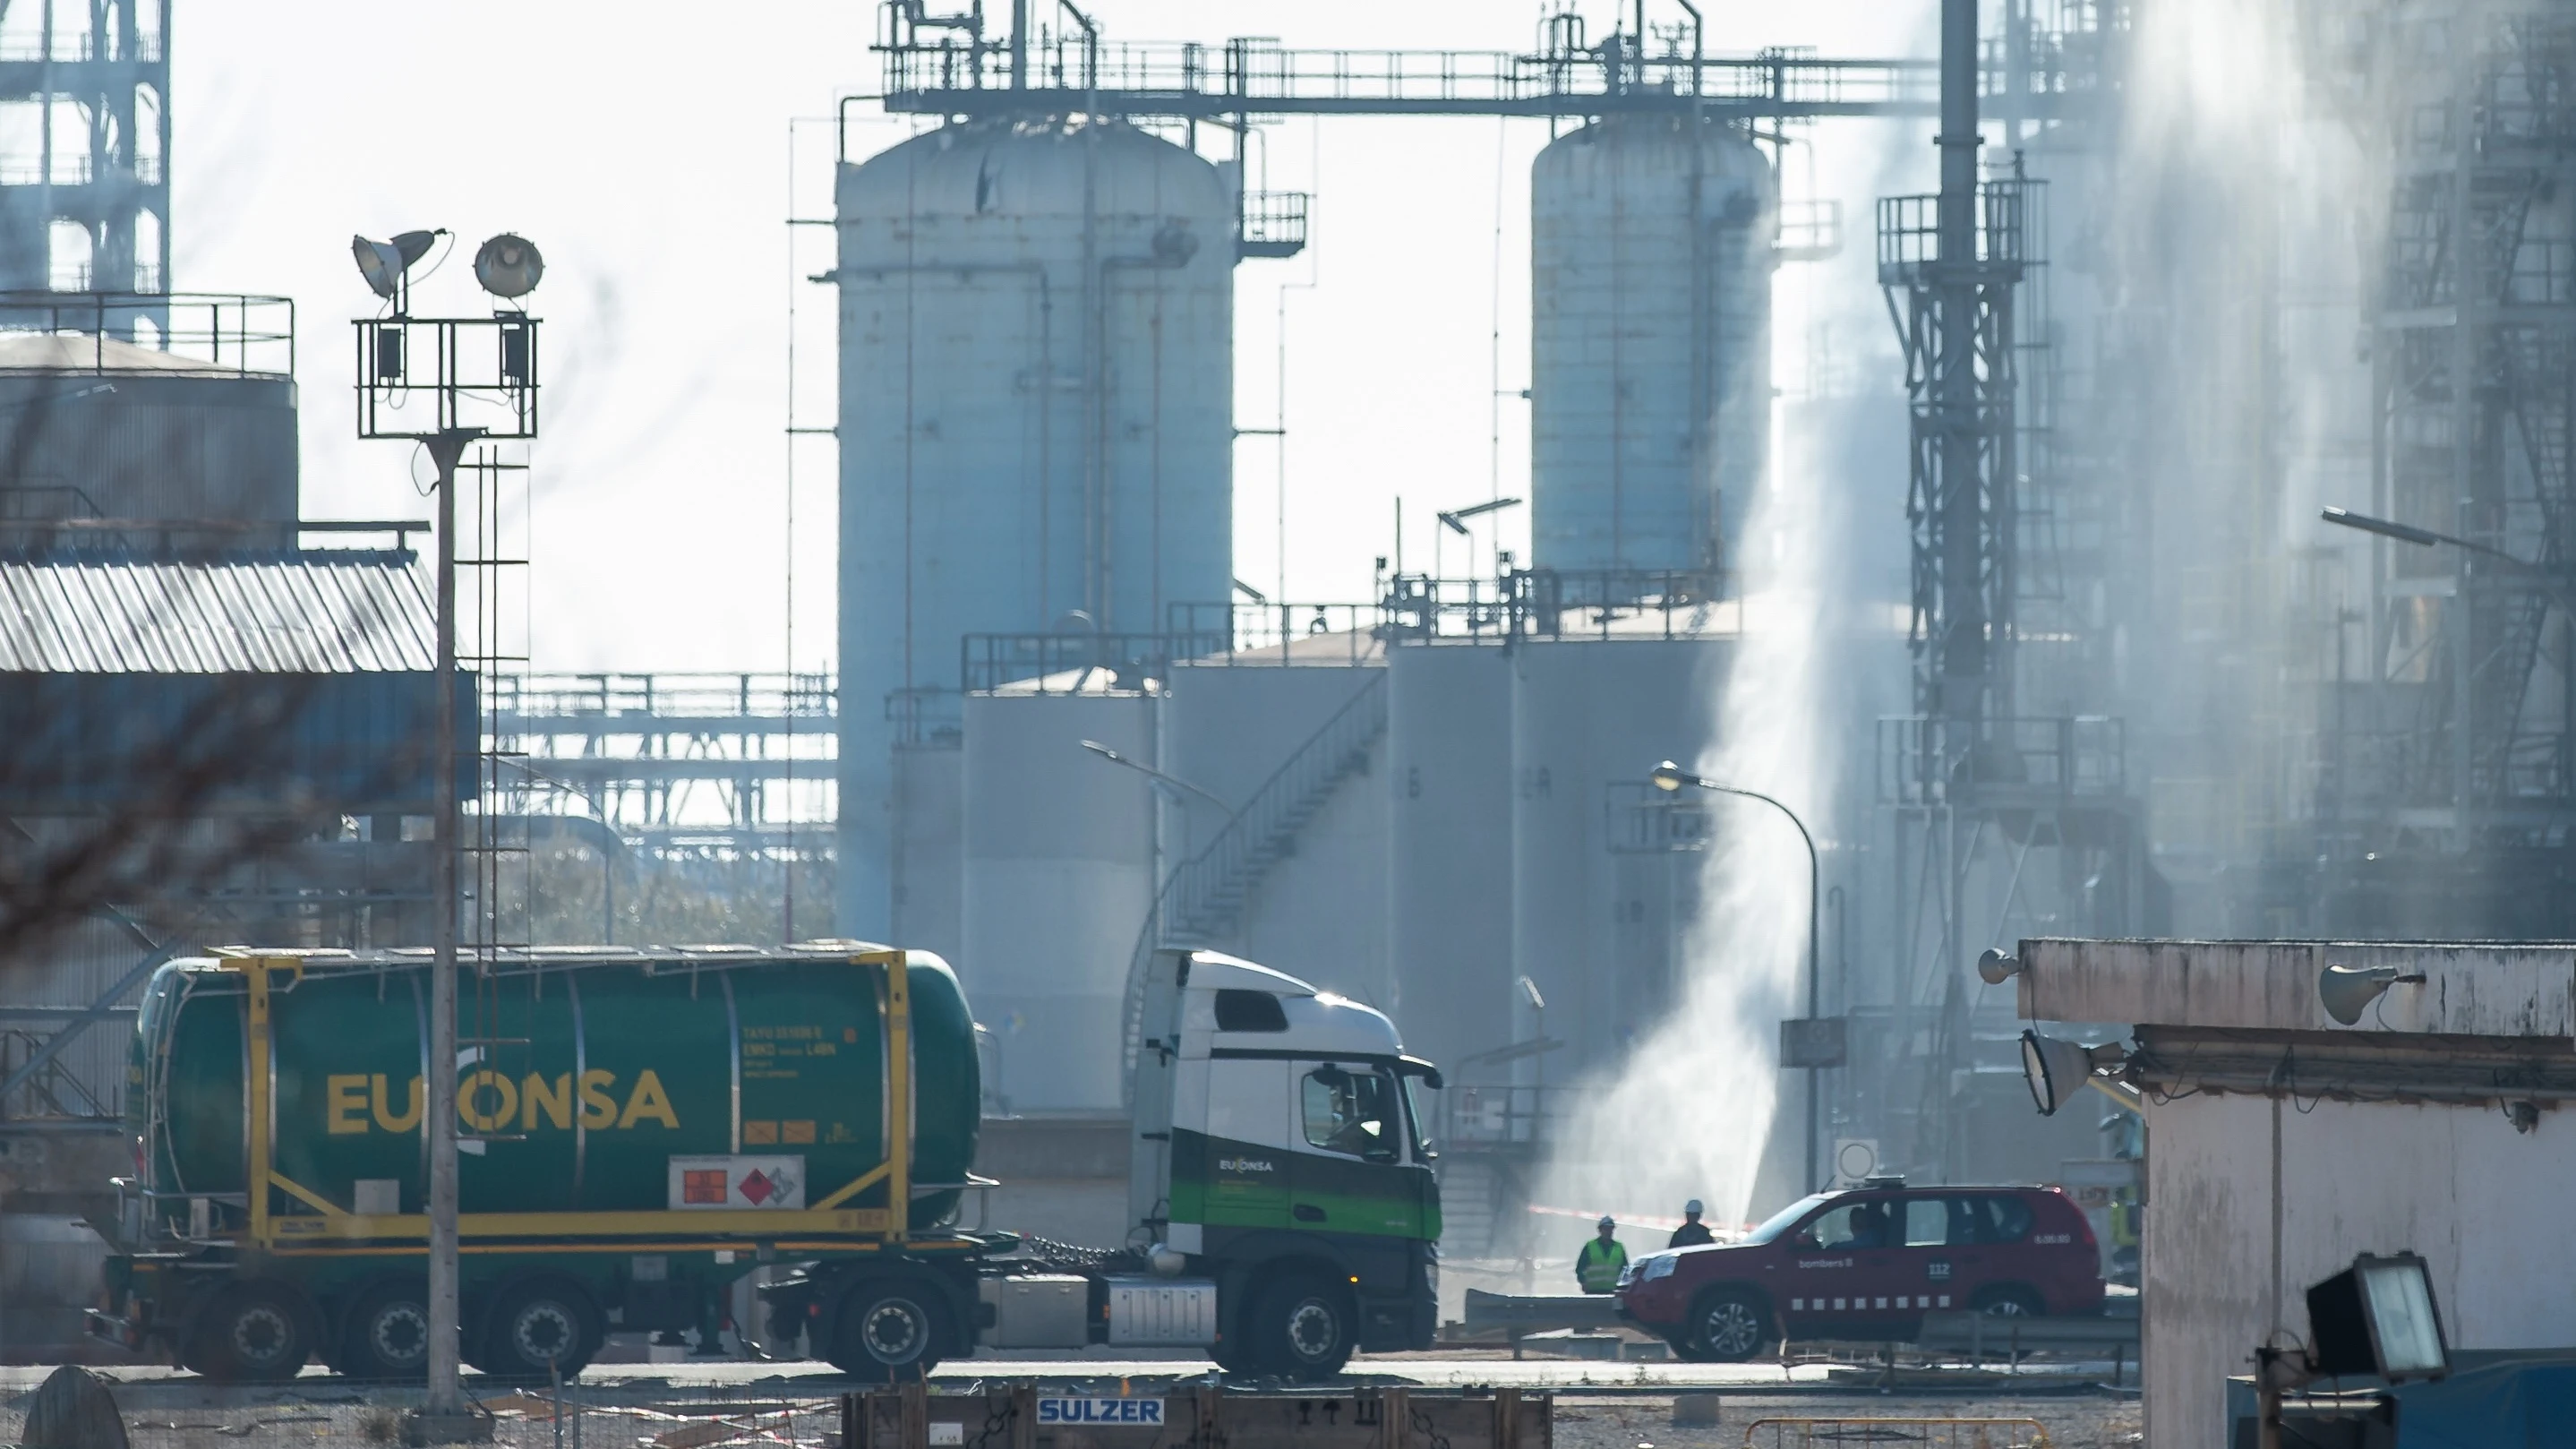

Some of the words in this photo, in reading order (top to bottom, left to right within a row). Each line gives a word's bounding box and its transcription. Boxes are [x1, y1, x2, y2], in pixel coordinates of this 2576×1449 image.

[1799, 1258, 1844, 1268] bombers
[1929, 1263, 1950, 1275] 112
[1039, 1399, 1162, 1423] SULZER
